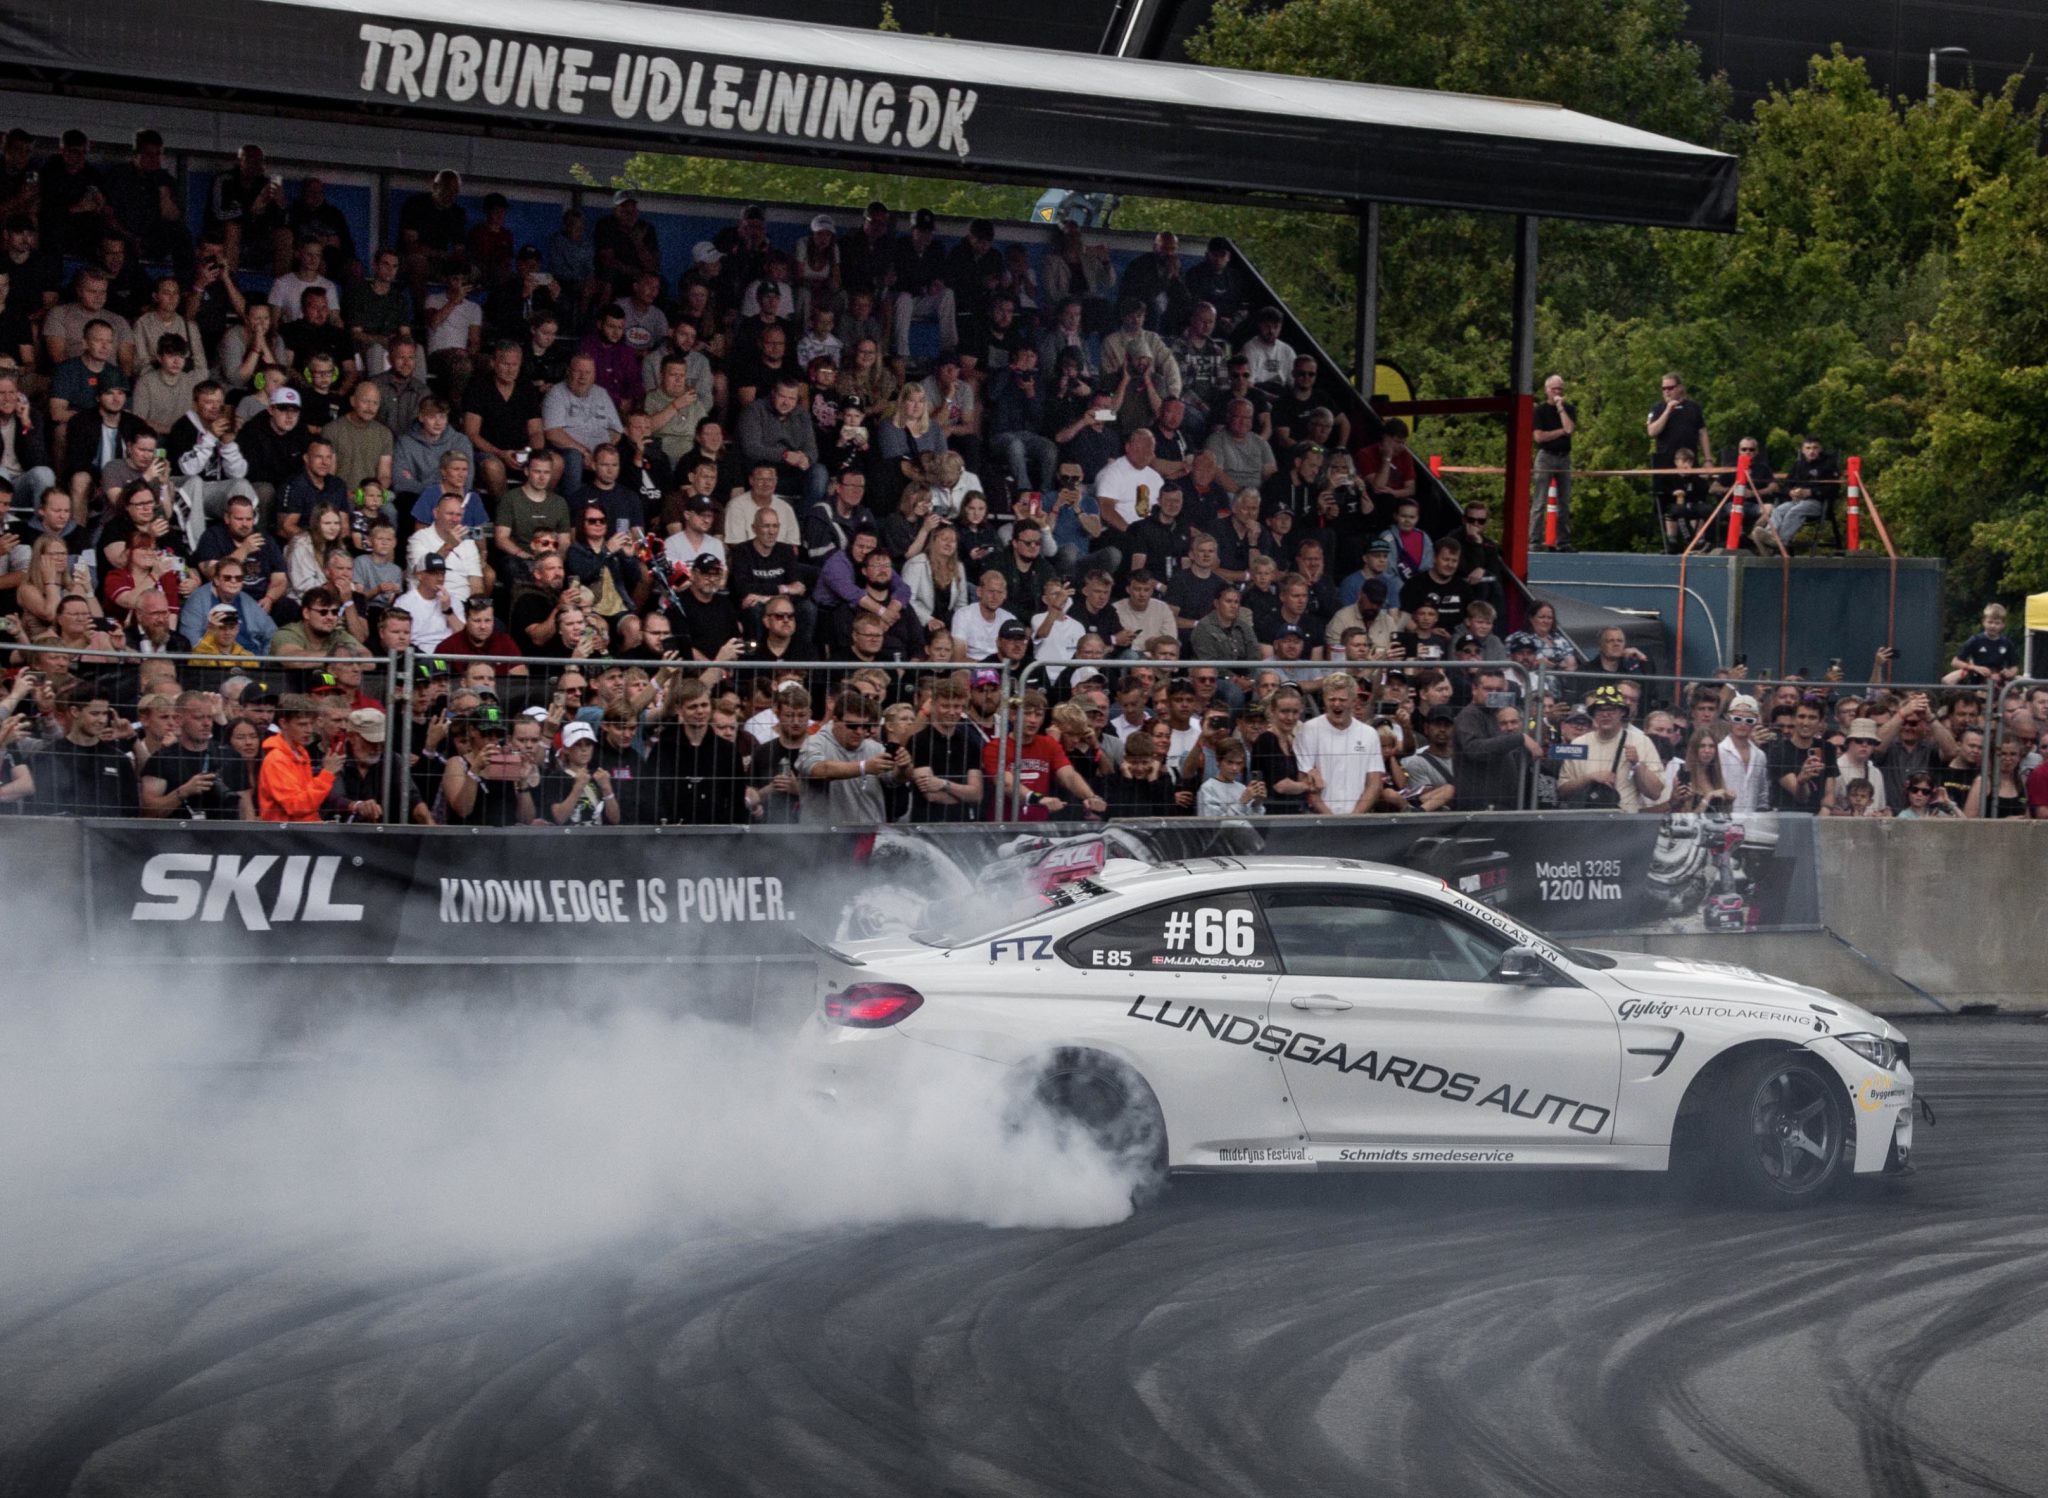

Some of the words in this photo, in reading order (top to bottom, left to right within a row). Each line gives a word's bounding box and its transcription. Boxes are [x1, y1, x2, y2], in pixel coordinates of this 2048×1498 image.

[359, 23, 978, 157] TRIBUNE-UDLEJNING.DK
[1046, 844, 1093, 868] SKIL
[1535, 861, 1583, 879] Model
[1585, 860, 1622, 877] 3285
[439, 878, 629, 924] KNOWLEDGE
[637, 878, 669, 923] IS
[678, 876, 796, 922] POWER.
[1539, 880, 1585, 901] 1200
[1588, 880, 1622, 900] Nm
[1163, 907, 1255, 957] #66
[1454, 898, 1530, 943] AUTOGLAS
[1531, 940, 1558, 962] FYN
[990, 935, 1053, 961] FTZ
[1092, 950, 1104, 965] E
[1106, 950, 1132, 967] 85
[1163, 955, 1265, 968] M.LUNDSGAARD
[1679, 1006, 1811, 1025] AUTOLAKERING
[1127, 995, 1480, 1102] LUNDSGAARDS
[1476, 1084, 1611, 1135] AUTO
[1267, 1147, 1306, 1161] Festival
[1339, 1149, 1408, 1162] Schmidts
[1411, 1149, 1514, 1162] smedeservice
